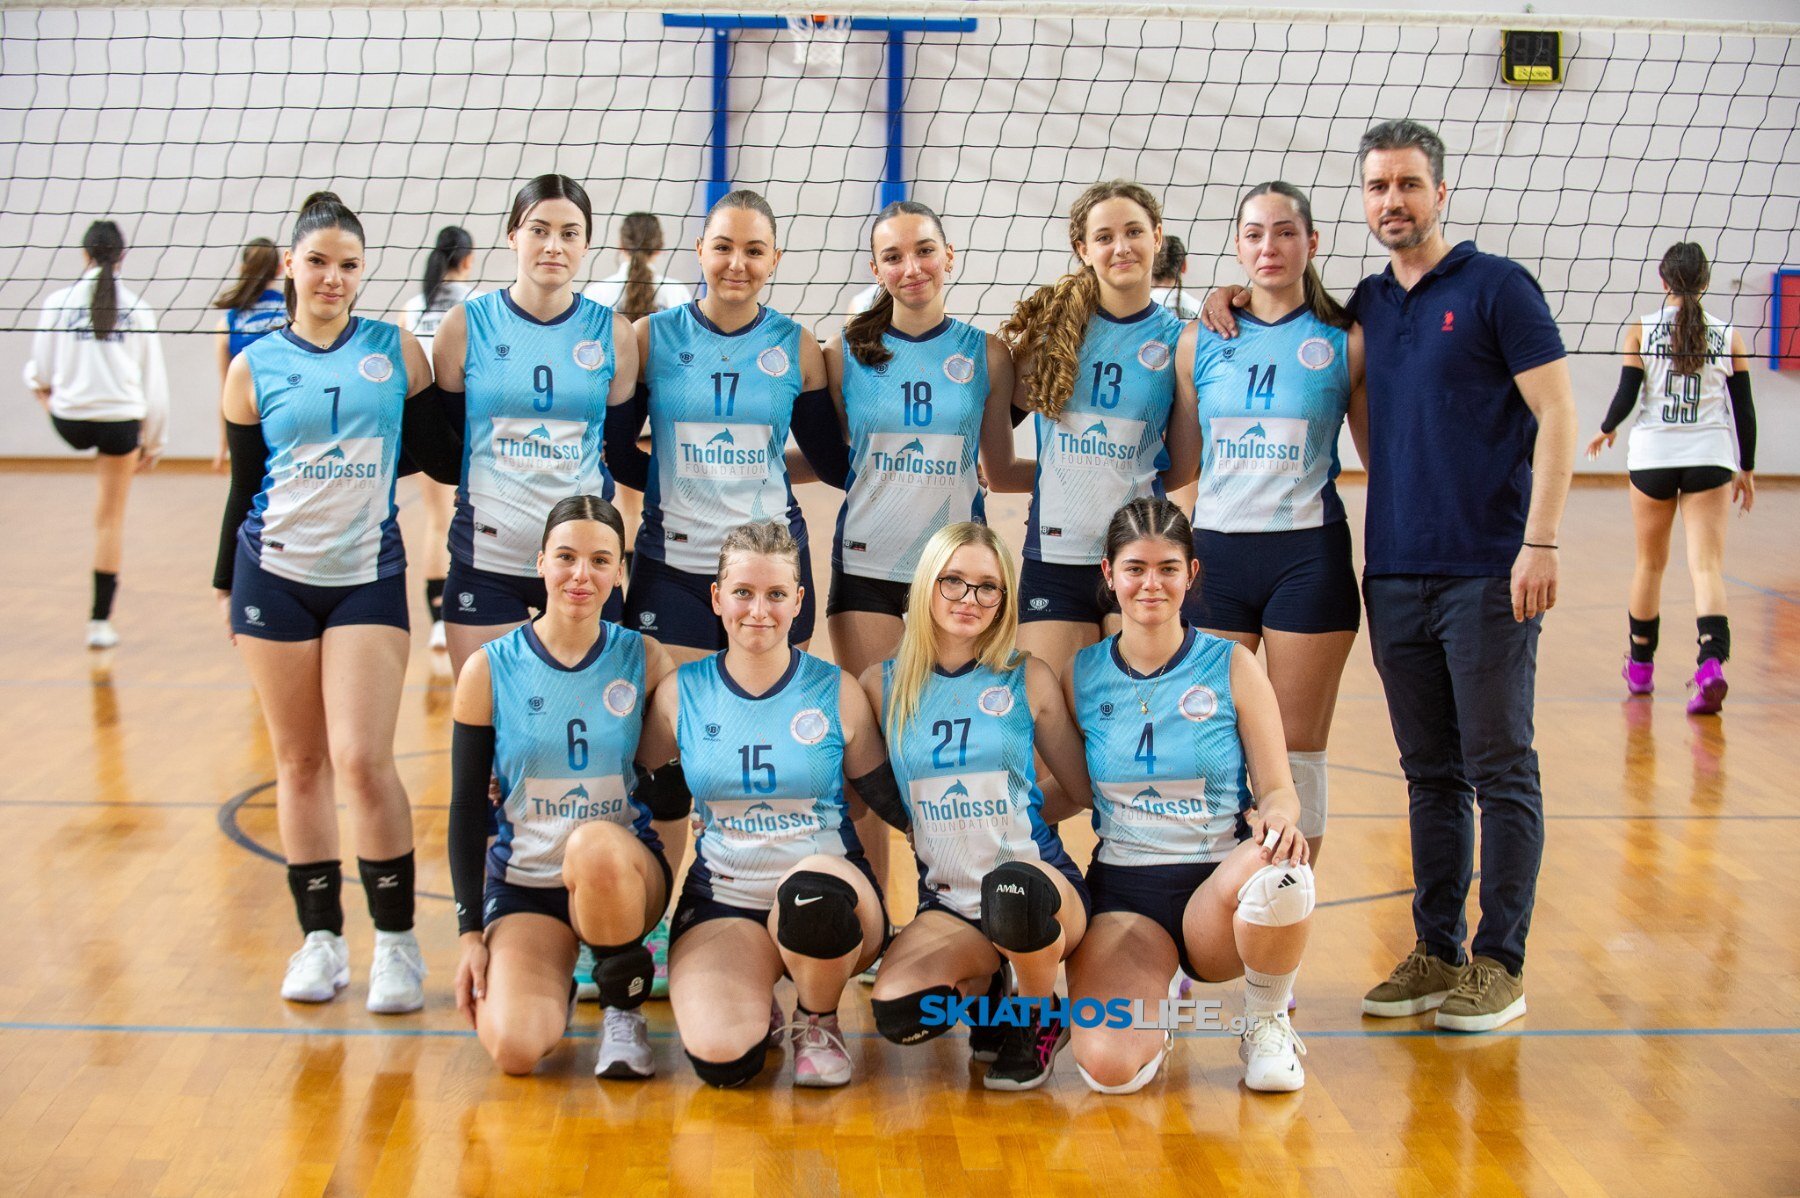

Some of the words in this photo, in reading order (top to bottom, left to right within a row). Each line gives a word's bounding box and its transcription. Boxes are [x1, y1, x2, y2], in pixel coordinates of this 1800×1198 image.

[533, 365, 554, 413] 9
[711, 372, 740, 417] 17
[1090, 360, 1124, 410] 13
[1244, 364, 1277, 410] 14
[1662, 369, 1701, 423] 59
[323, 386, 341, 435] 7
[900, 381, 933, 427] 18
[497, 437, 580, 460] Thalassa
[680, 443, 765, 465] Thalassa
[872, 451, 957, 475] Thalassa
[1058, 432, 1136, 460] Thalassa
[1216, 438, 1300, 461] Thalassa
[685, 463, 765, 475] FOUNDATION
[875, 471, 955, 486] FOUNDATION
[566, 718, 589, 771] 6
[931, 717, 972, 770] 27
[1134, 722, 1157, 774] 4
[738, 744, 777, 794] 15
[531, 797, 624, 819] Thalassa
[917, 799, 1008, 821] Thalassa
[926, 816, 1009, 832] FOUNDATION
[996, 883, 1025, 896] AMILA
